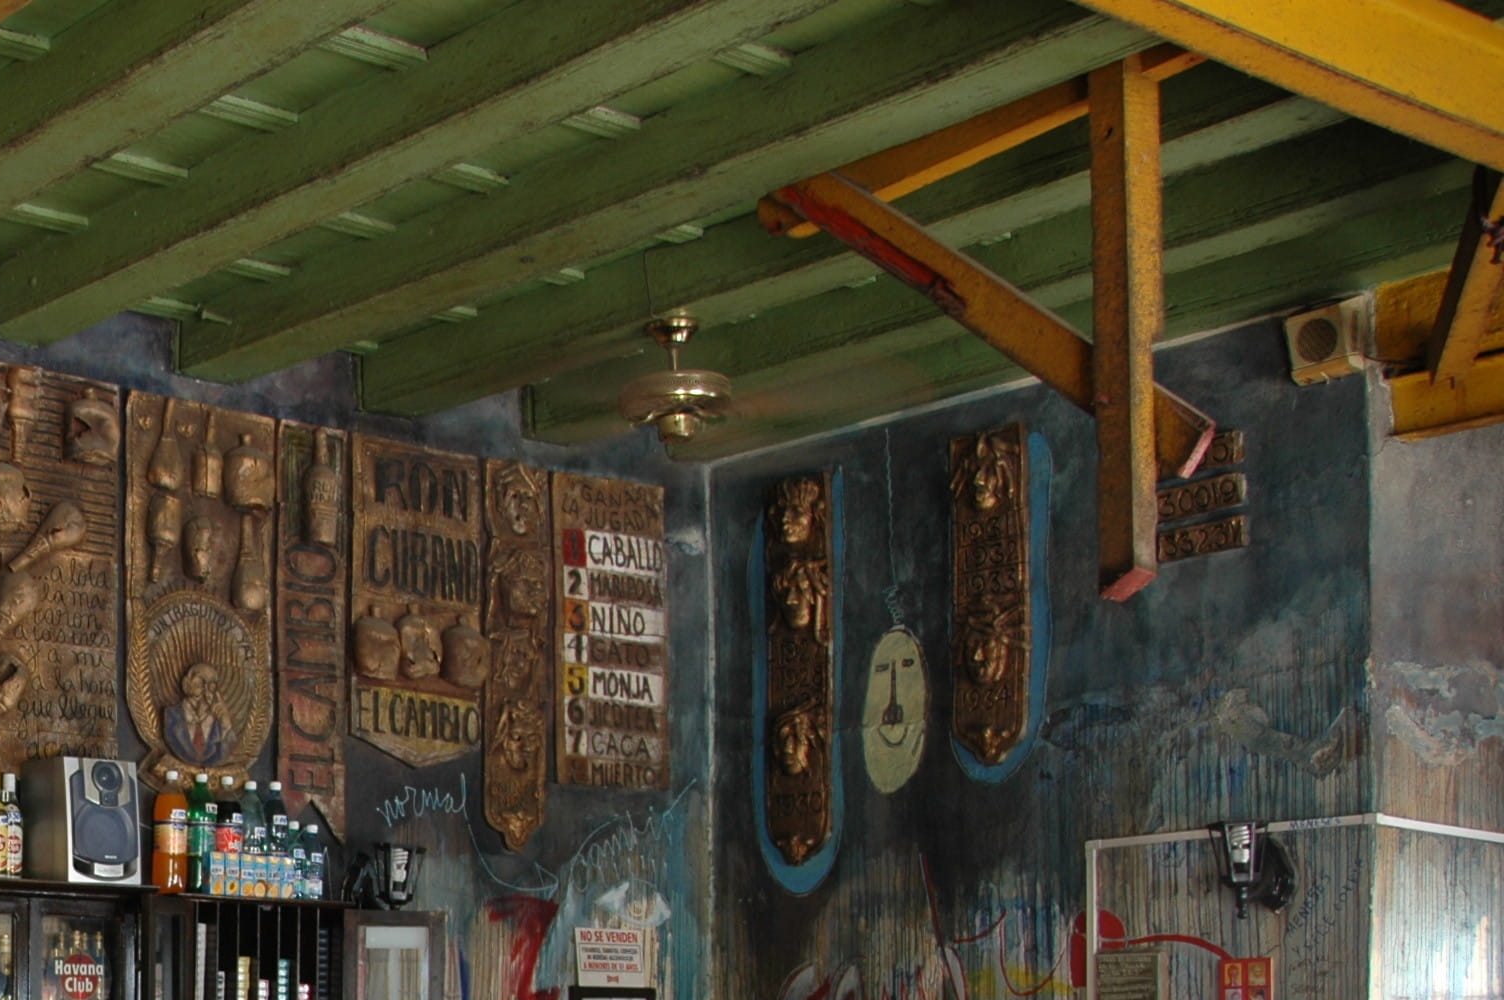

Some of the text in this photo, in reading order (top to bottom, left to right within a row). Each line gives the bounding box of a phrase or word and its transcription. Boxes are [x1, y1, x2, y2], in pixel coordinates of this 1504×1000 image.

[374, 459, 471, 523] RON
[369, 525, 479, 604] CUBANO
[587, 534, 664, 573] CABALLO
[567, 567, 583, 597] 2
[284, 543, 338, 745] CAMBIO
[566, 633, 584, 664] 4
[567, 666, 654, 704] 5 MONJA
[355, 686, 481, 747] EL CAMBIO
[567, 698, 585, 726] 6
[591, 731, 652, 761] CACA
[289, 746, 336, 798] EL
[579, 930, 639, 944] NO SE VENDEN
[54, 959, 105, 977] Havana
[64, 975, 95, 994] Club
